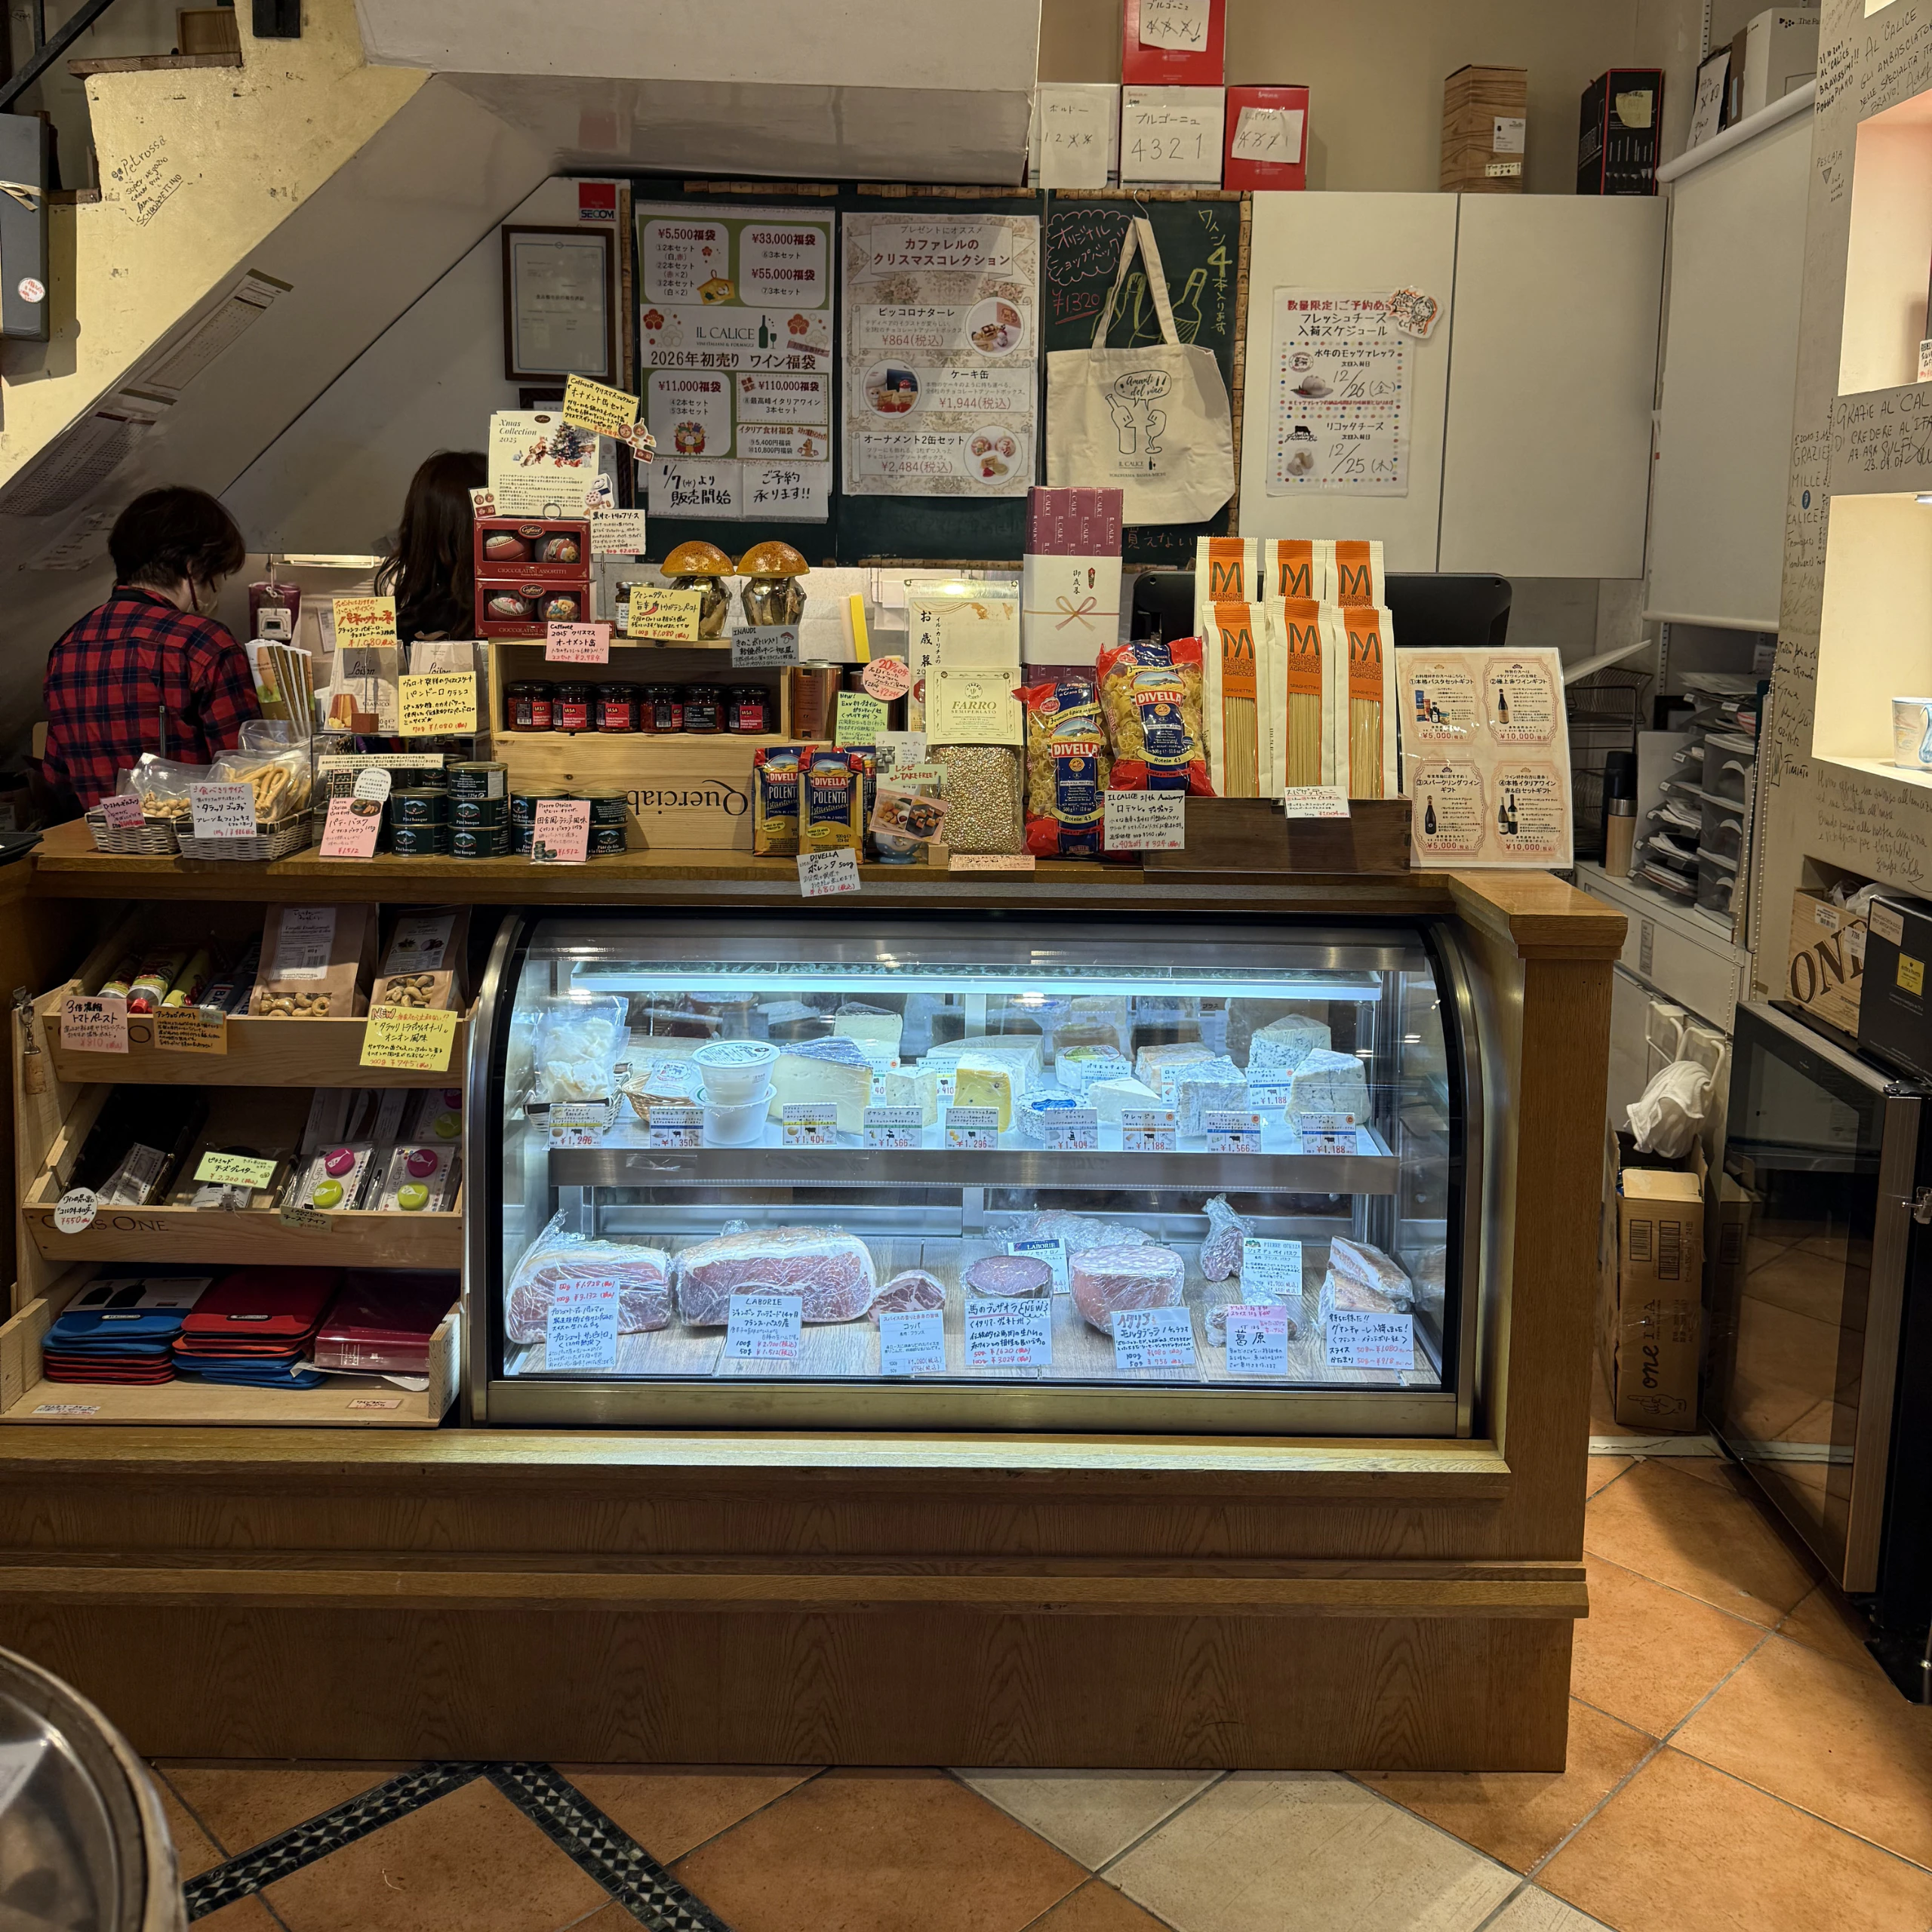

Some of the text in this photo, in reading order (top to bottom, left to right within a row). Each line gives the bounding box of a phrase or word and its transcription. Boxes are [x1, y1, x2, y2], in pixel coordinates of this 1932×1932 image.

[1136, 115, 1201, 125] ブルゴーニュ
[580, 209, 616, 219] SECOM
[658, 228, 716, 241] ¥5,500福袋
[900, 226, 982, 235] プレゼントにオススメ
[752, 233, 816, 246] ¥33,000福袋
[1051, 225, 1110, 250] オリジナル
[905, 238, 979, 251] カファレルの
[1051, 228, 1124, 276] ショップバッグ
[874, 253, 1010, 266] クリスマスコレクション
[751, 269, 815, 281] ¥55,000福袋
[878, 307, 955, 317] ピッコロナターレ
[1301, 312, 1387, 324] フレッシュチーズ
[696, 327, 755, 340] IL CALICE
[1298, 326, 1388, 337] 入荷スケジュール
[882, 334, 943, 347] ¥864(税込)
[1314, 349, 1395, 358] 水牛のモッツァレッラ
[651, 351, 816, 370] 2026年初売り ワイン福袋
[951, 370, 989, 380] ケーキ缶
[658, 380, 721, 392] ¥11,000福袋
[758, 380, 820, 392] ¥110,000福袋
[1131, 386, 1146, 397] del
[939, 398, 1011, 410] ¥1,944(税込)
[1881, 403, 1894, 415] AL
[499, 419, 521, 427] Xmas
[1327, 422, 1383, 431] リコッタチーズ
[739, 426, 794, 435] イタリア食材福袋
[1851, 425, 1892, 445] CREDERE
[864, 435, 964, 445] オーナメント2缶セット
[1792, 445, 1829, 467] GRAZIE
[881, 461, 952, 473] ¥2,484(税込)
[762, 470, 800, 485] ご予約
[671, 490, 731, 508] 販売開始
[1211, 561, 1242, 592] M
[921, 610, 932, 666] お歳暮
[1223, 628, 1253, 658] M
[1288, 623, 1319, 656] M
[1349, 632, 1380, 663] M
[1289, 653, 1319, 662] MANCINI
[1289, 666, 1320, 674] AGRICOLO
[1137, 692, 1182, 705] DIVELLA
[952, 701, 997, 709] FARRO
[1054, 744, 1099, 755] DIVELLA
[895, 764, 915, 773] レシピ
[814, 778, 847, 786] DIVELLA
[900, 772, 918, 780] TAKE
[814, 792, 847, 804] POLENTA
[810, 850, 839, 861] DIVELLA
[808, 861, 836, 873] ポレンタ
[73, 1012, 118, 1023] トマトペースト
[371, 1008, 396, 1020] NEW
[385, 1033, 428, 1043] オニオン風味
[305, 1167, 323, 1200] Wine Cap
[387, 1181, 399, 1200] Wine
[113, 1216, 168, 1232] ONE
[968, 1303, 1017, 1315] 馬のブレザオラ
[1024, 1303, 1043, 1312] NEW
